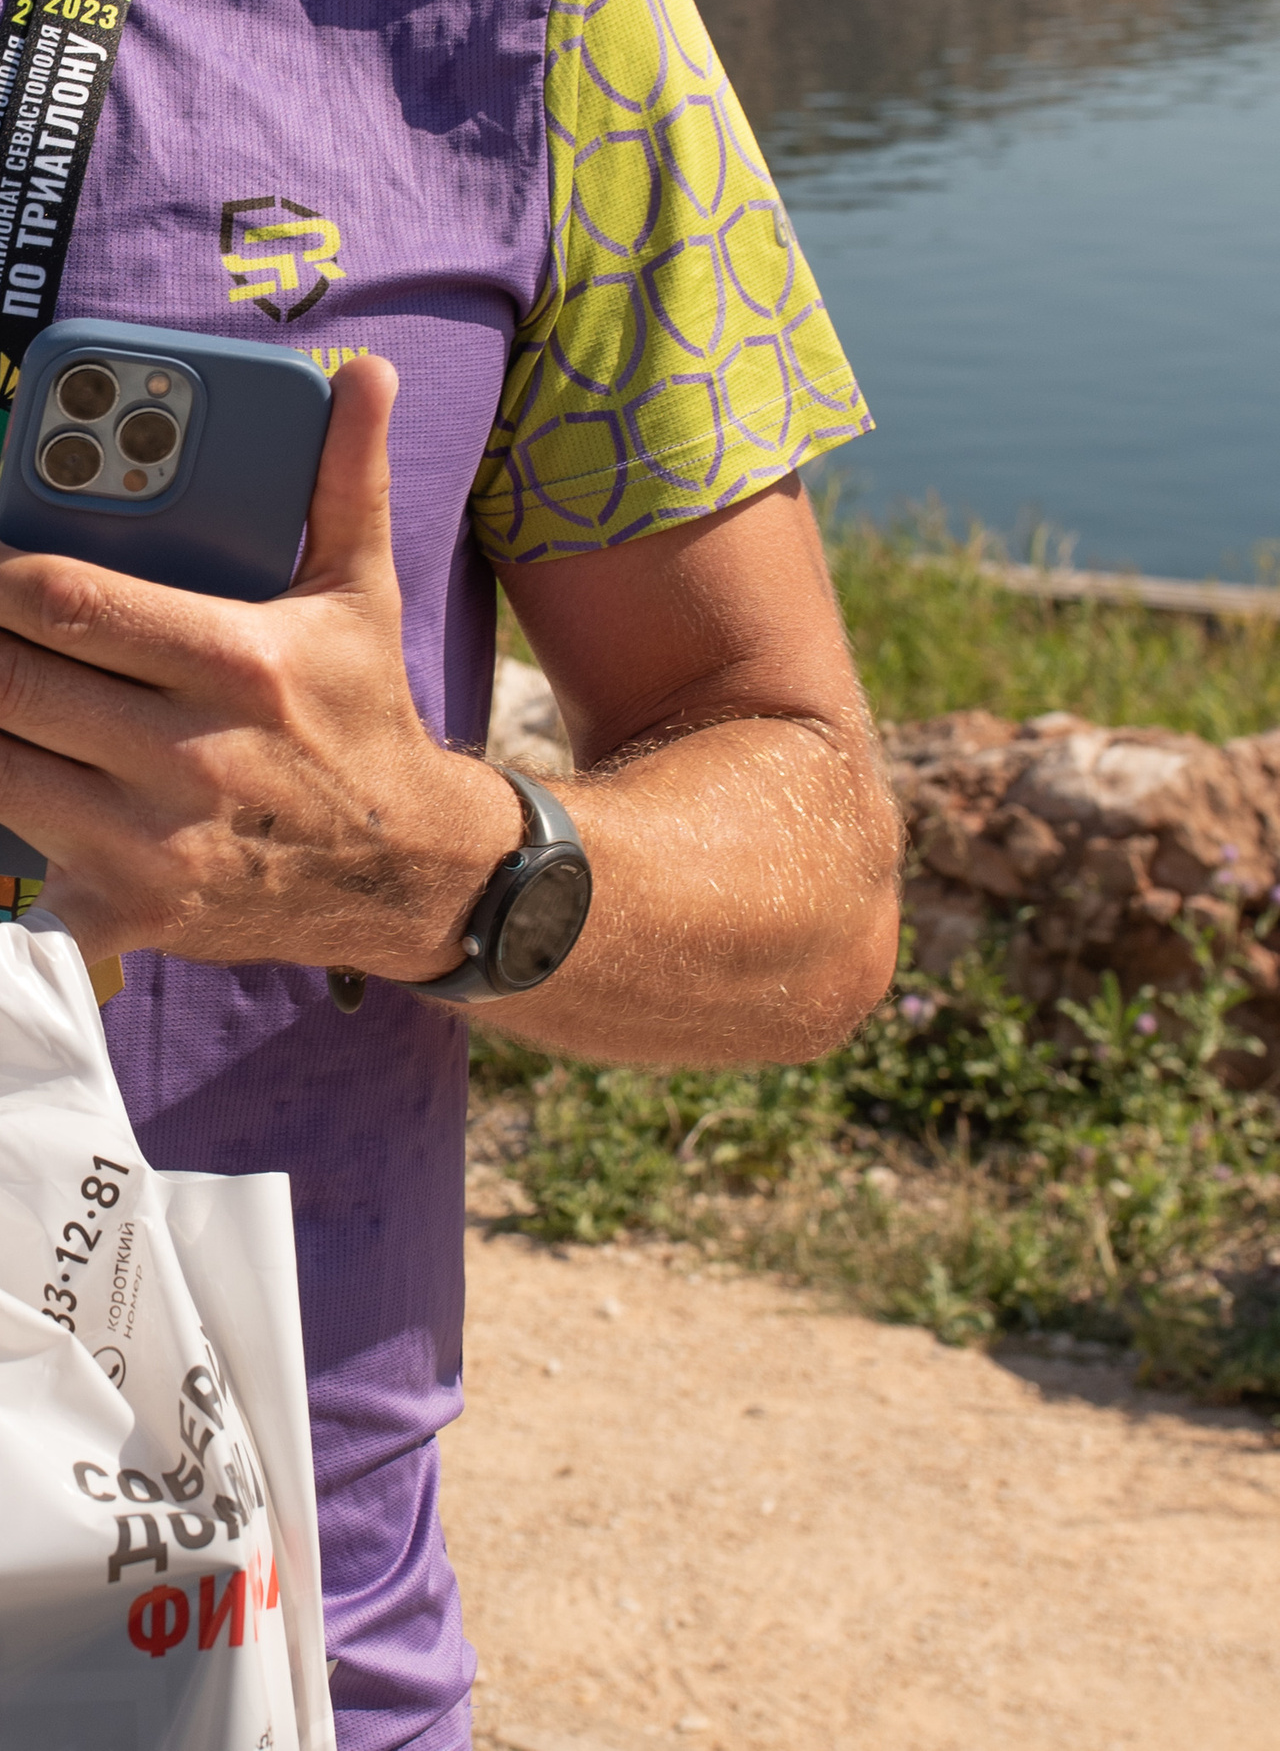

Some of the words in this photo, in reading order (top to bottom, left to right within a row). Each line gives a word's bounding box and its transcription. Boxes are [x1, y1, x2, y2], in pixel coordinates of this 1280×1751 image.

[5, 24, 63, 172] СЕВАСТОПОЛЯ
[16, 32, 108, 248] ТРИАТЛОНУ
[2, 263, 47, 318] ПО
[73, 1343, 228, 1503] СОБЕР
